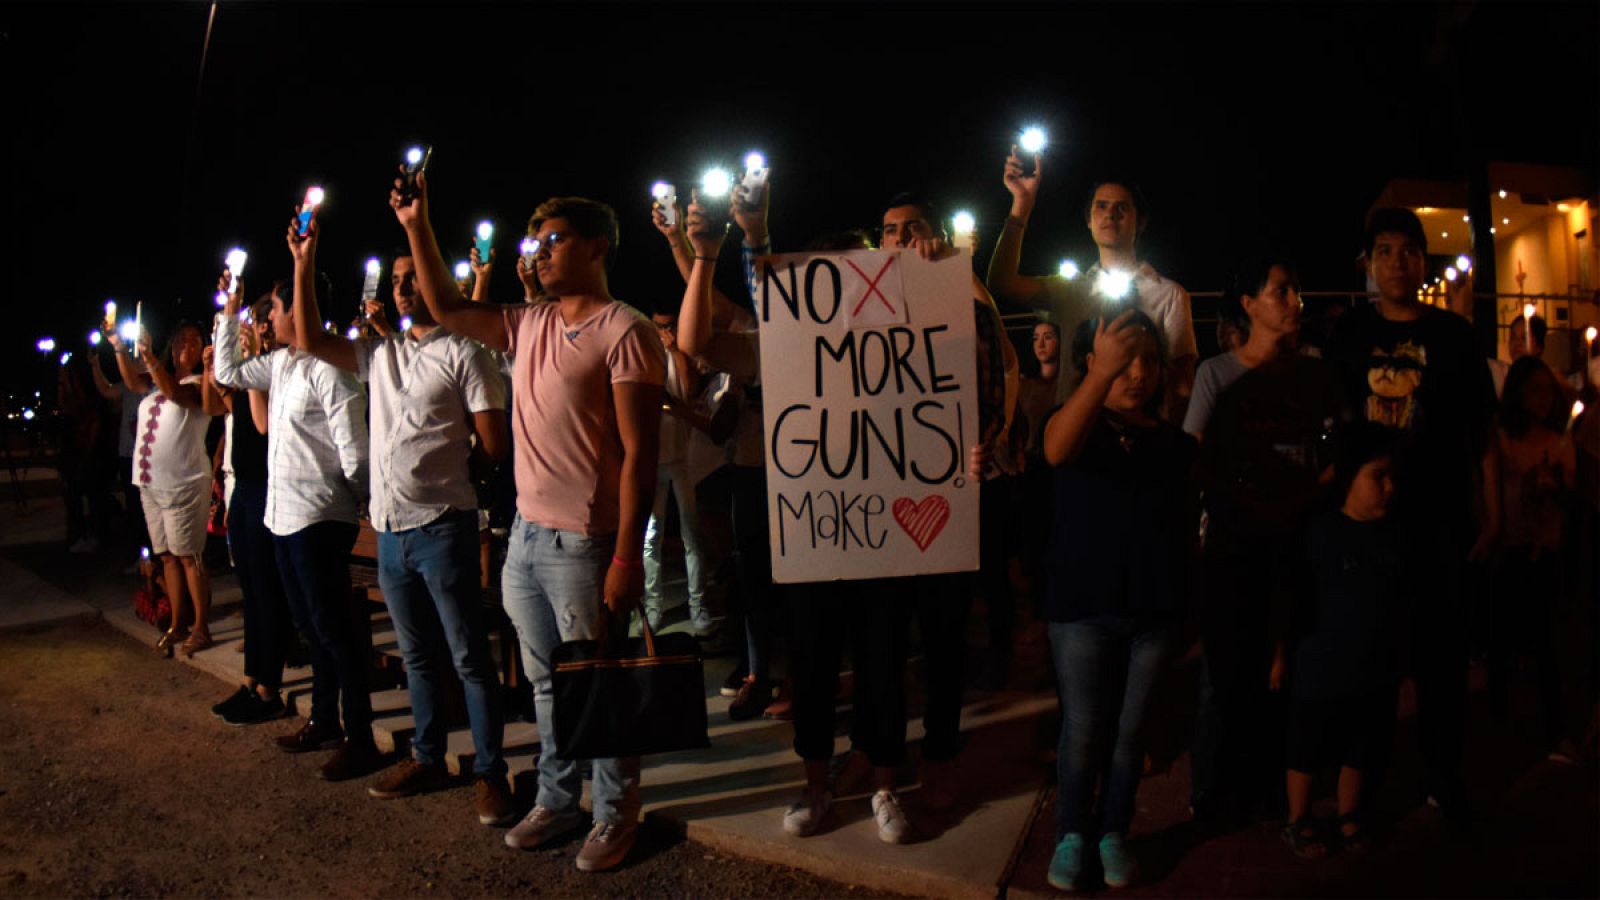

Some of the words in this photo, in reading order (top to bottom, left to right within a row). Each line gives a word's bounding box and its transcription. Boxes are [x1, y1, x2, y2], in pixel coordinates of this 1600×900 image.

[762, 257, 842, 326] NO
[815, 324, 961, 398] MORE
[771, 399, 966, 488] GUNS!
[777, 489, 889, 557] Make
